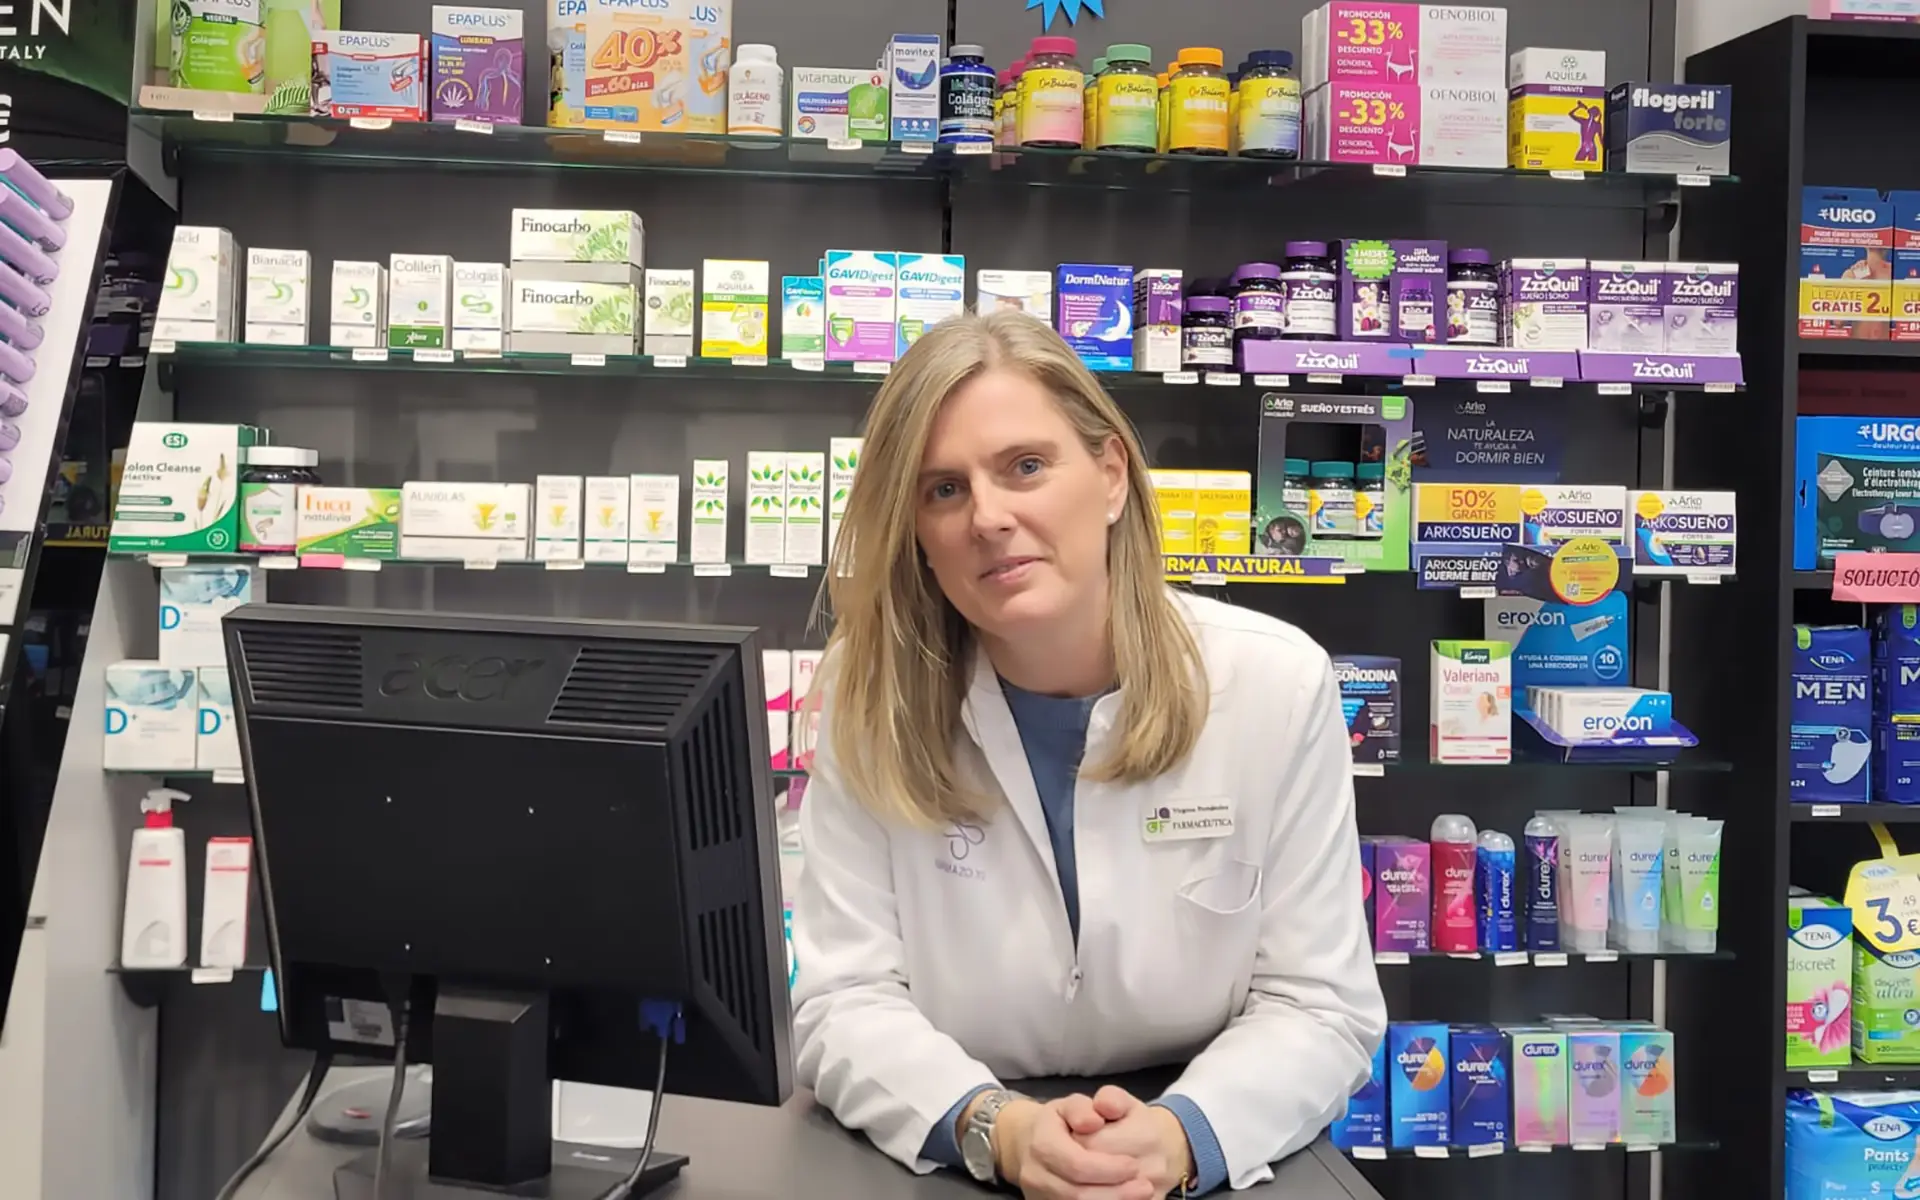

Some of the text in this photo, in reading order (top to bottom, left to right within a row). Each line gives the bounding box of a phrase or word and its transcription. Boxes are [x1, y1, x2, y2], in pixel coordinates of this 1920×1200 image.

[447, 13, 507, 28] EPAPLUS
[1338, 9, 1391, 20] PROMOCIÓN
[1428, 8, 1497, 22] OENOBIOL
[1337, 19, 1404, 46] -33%
[338, 35, 391, 48] EPAPLUS
[895, 47, 936, 57] movitex
[1337, 46, 1383, 55] DESCUENTO
[797, 72, 858, 85] vitanatur
[1545, 71, 1587, 81] AQUILEA
[607, 76, 632, 93] 60
[1339, 90, 1392, 100] PROMOCIÓN
[1430, 88, 1497, 103] OENOBIOL
[1632, 87, 1715, 113] flogeril
[1338, 99, 1405, 126] -33%
[1674, 112, 1727, 132] forte
[1339, 126, 1384, 135] DESCUENTO
[1829, 207, 1876, 223] URGO
[521, 217, 592, 234] Finocarbo
[252, 254, 303, 267] Bianacid
[393, 259, 442, 274] Colilen
[455, 269, 500, 283] Coligas
[648, 276, 691, 287] Finocarbo
[829, 267, 894, 284] GAVIDigest
[900, 270, 962, 286] GAVIDigest
[1520, 275, 1580, 292] ZzzQuil
[1598, 277, 1660, 296] ZzzQuil
[1672, 278, 1732, 298] ZzzQuil
[521, 288, 594, 306] Finocarbo
[1812, 289, 1863, 301] LLEVATE
[1812, 301, 1862, 313] GRATIS
[1295, 350, 1359, 369] ZzzQuil
[1466, 355, 1528, 374] ZzzQuil
[1632, 359, 1694, 378] ZzzQuil
[1301, 403, 1333, 413] SUEÑO
[1341, 403, 1374, 414] ESTRÉS
[1465, 401, 1486, 411] Arko
[166, 435, 185, 446] ESI
[1447, 428, 1535, 442] NATURALEZA
[1455, 451, 1545, 465] DORMIR BIEN
[156, 462, 202, 474] Cleanse
[1863, 466, 1896, 477] Ceinture
[1451, 489, 1497, 509] 50%
[1568, 490, 1592, 500] Arko
[1679, 495, 1703, 505] Arko
[1451, 509, 1496, 520] GRATIS
[1529, 508, 1618, 524] ARKOSUEÑO
[1640, 512, 1729, 530] ARKOSUEÑO
[1423, 523, 1513, 539] ARKOSUEÑO
[1166, 557, 1305, 575] RMA NATURAL
[1425, 556, 1499, 571] ARKOSUEÑO
[1424, 571, 1497, 581] DUERME BIEN
[1497, 610, 1565, 626] eroxon
[1600, 653, 1615, 665] 10
[1819, 655, 1845, 665] TENA
[378, 653, 545, 702] acer
[1443, 669, 1500, 683] Valeriana
[1796, 681, 1866, 700] MEN
[1583, 715, 1652, 731] eroxon
[1791, 779, 1805, 787] x24
[1579, 851, 1609, 863] durex
[1630, 851, 1660, 862] durex
[1688, 851, 1717, 863] durex
[1381, 869, 1418, 882] durex
[1540, 855, 1552, 899] durex
[1501, 870, 1510, 909] durex
[1903, 894, 1917, 906] 49
[1866, 896, 1903, 944] 3
[1803, 930, 1832, 941] TENA
[1876, 985, 1914, 999] ultra
[1524, 1044, 1558, 1055] durex
[1457, 1061, 1492, 1072] durex
[1573, 1059, 1607, 1071] durex
[1624, 1059, 1658, 1070] durex
[1873, 1122, 1901, 1132] TENA
[1864, 1147, 1909, 1162] Pants
[1871, 1181, 1881, 1194] S
